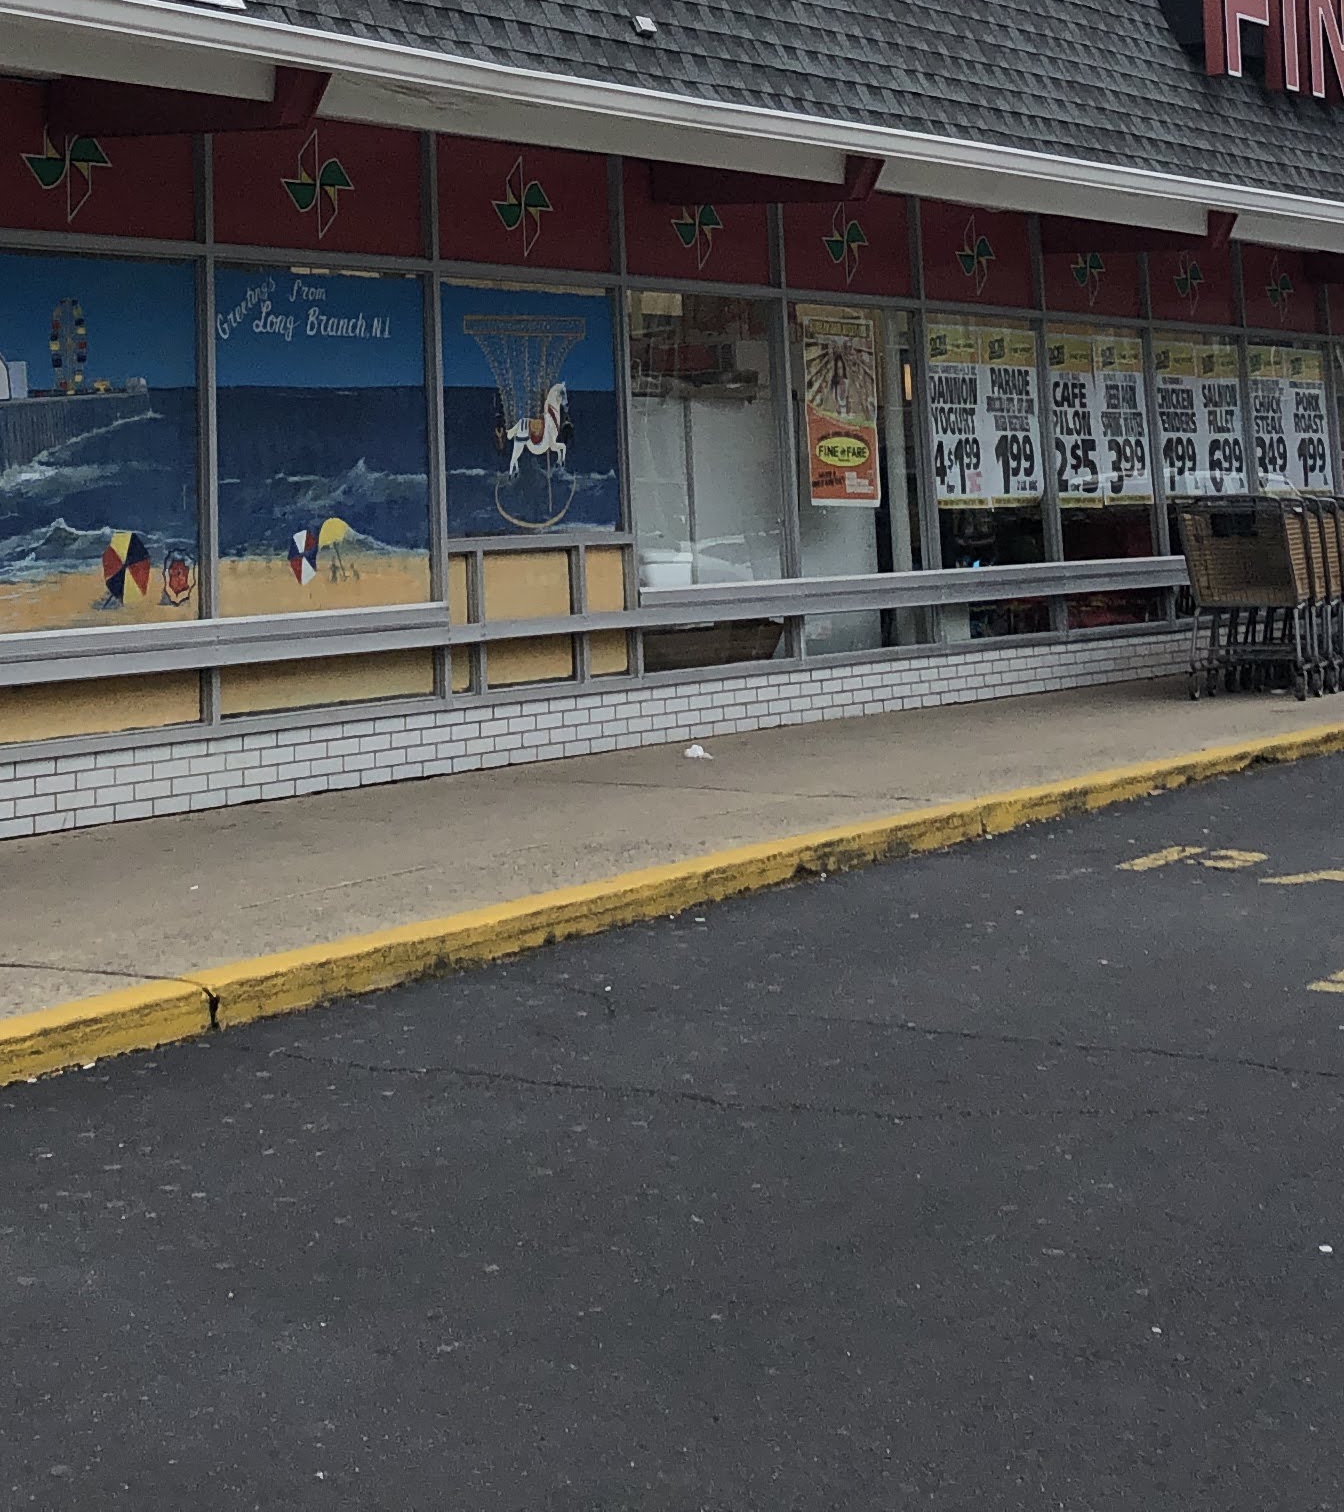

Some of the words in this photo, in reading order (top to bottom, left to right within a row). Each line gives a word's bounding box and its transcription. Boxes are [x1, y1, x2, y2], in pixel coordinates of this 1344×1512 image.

[253, 300, 301, 342] Long
[989, 367, 1031, 396] PARADE
[1053, 381, 1087, 408] CAFE
[1295, 391, 1322, 413] PORK
[931, 407, 976, 435] YOGURT
[1158, 411, 1197, 434] ENDERS
[1254, 415, 1284, 435] STEAK
[1293, 413, 1325, 434] ROAST
[818, 445, 838, 458] FINE
[847, 446, 867, 459] FARE
